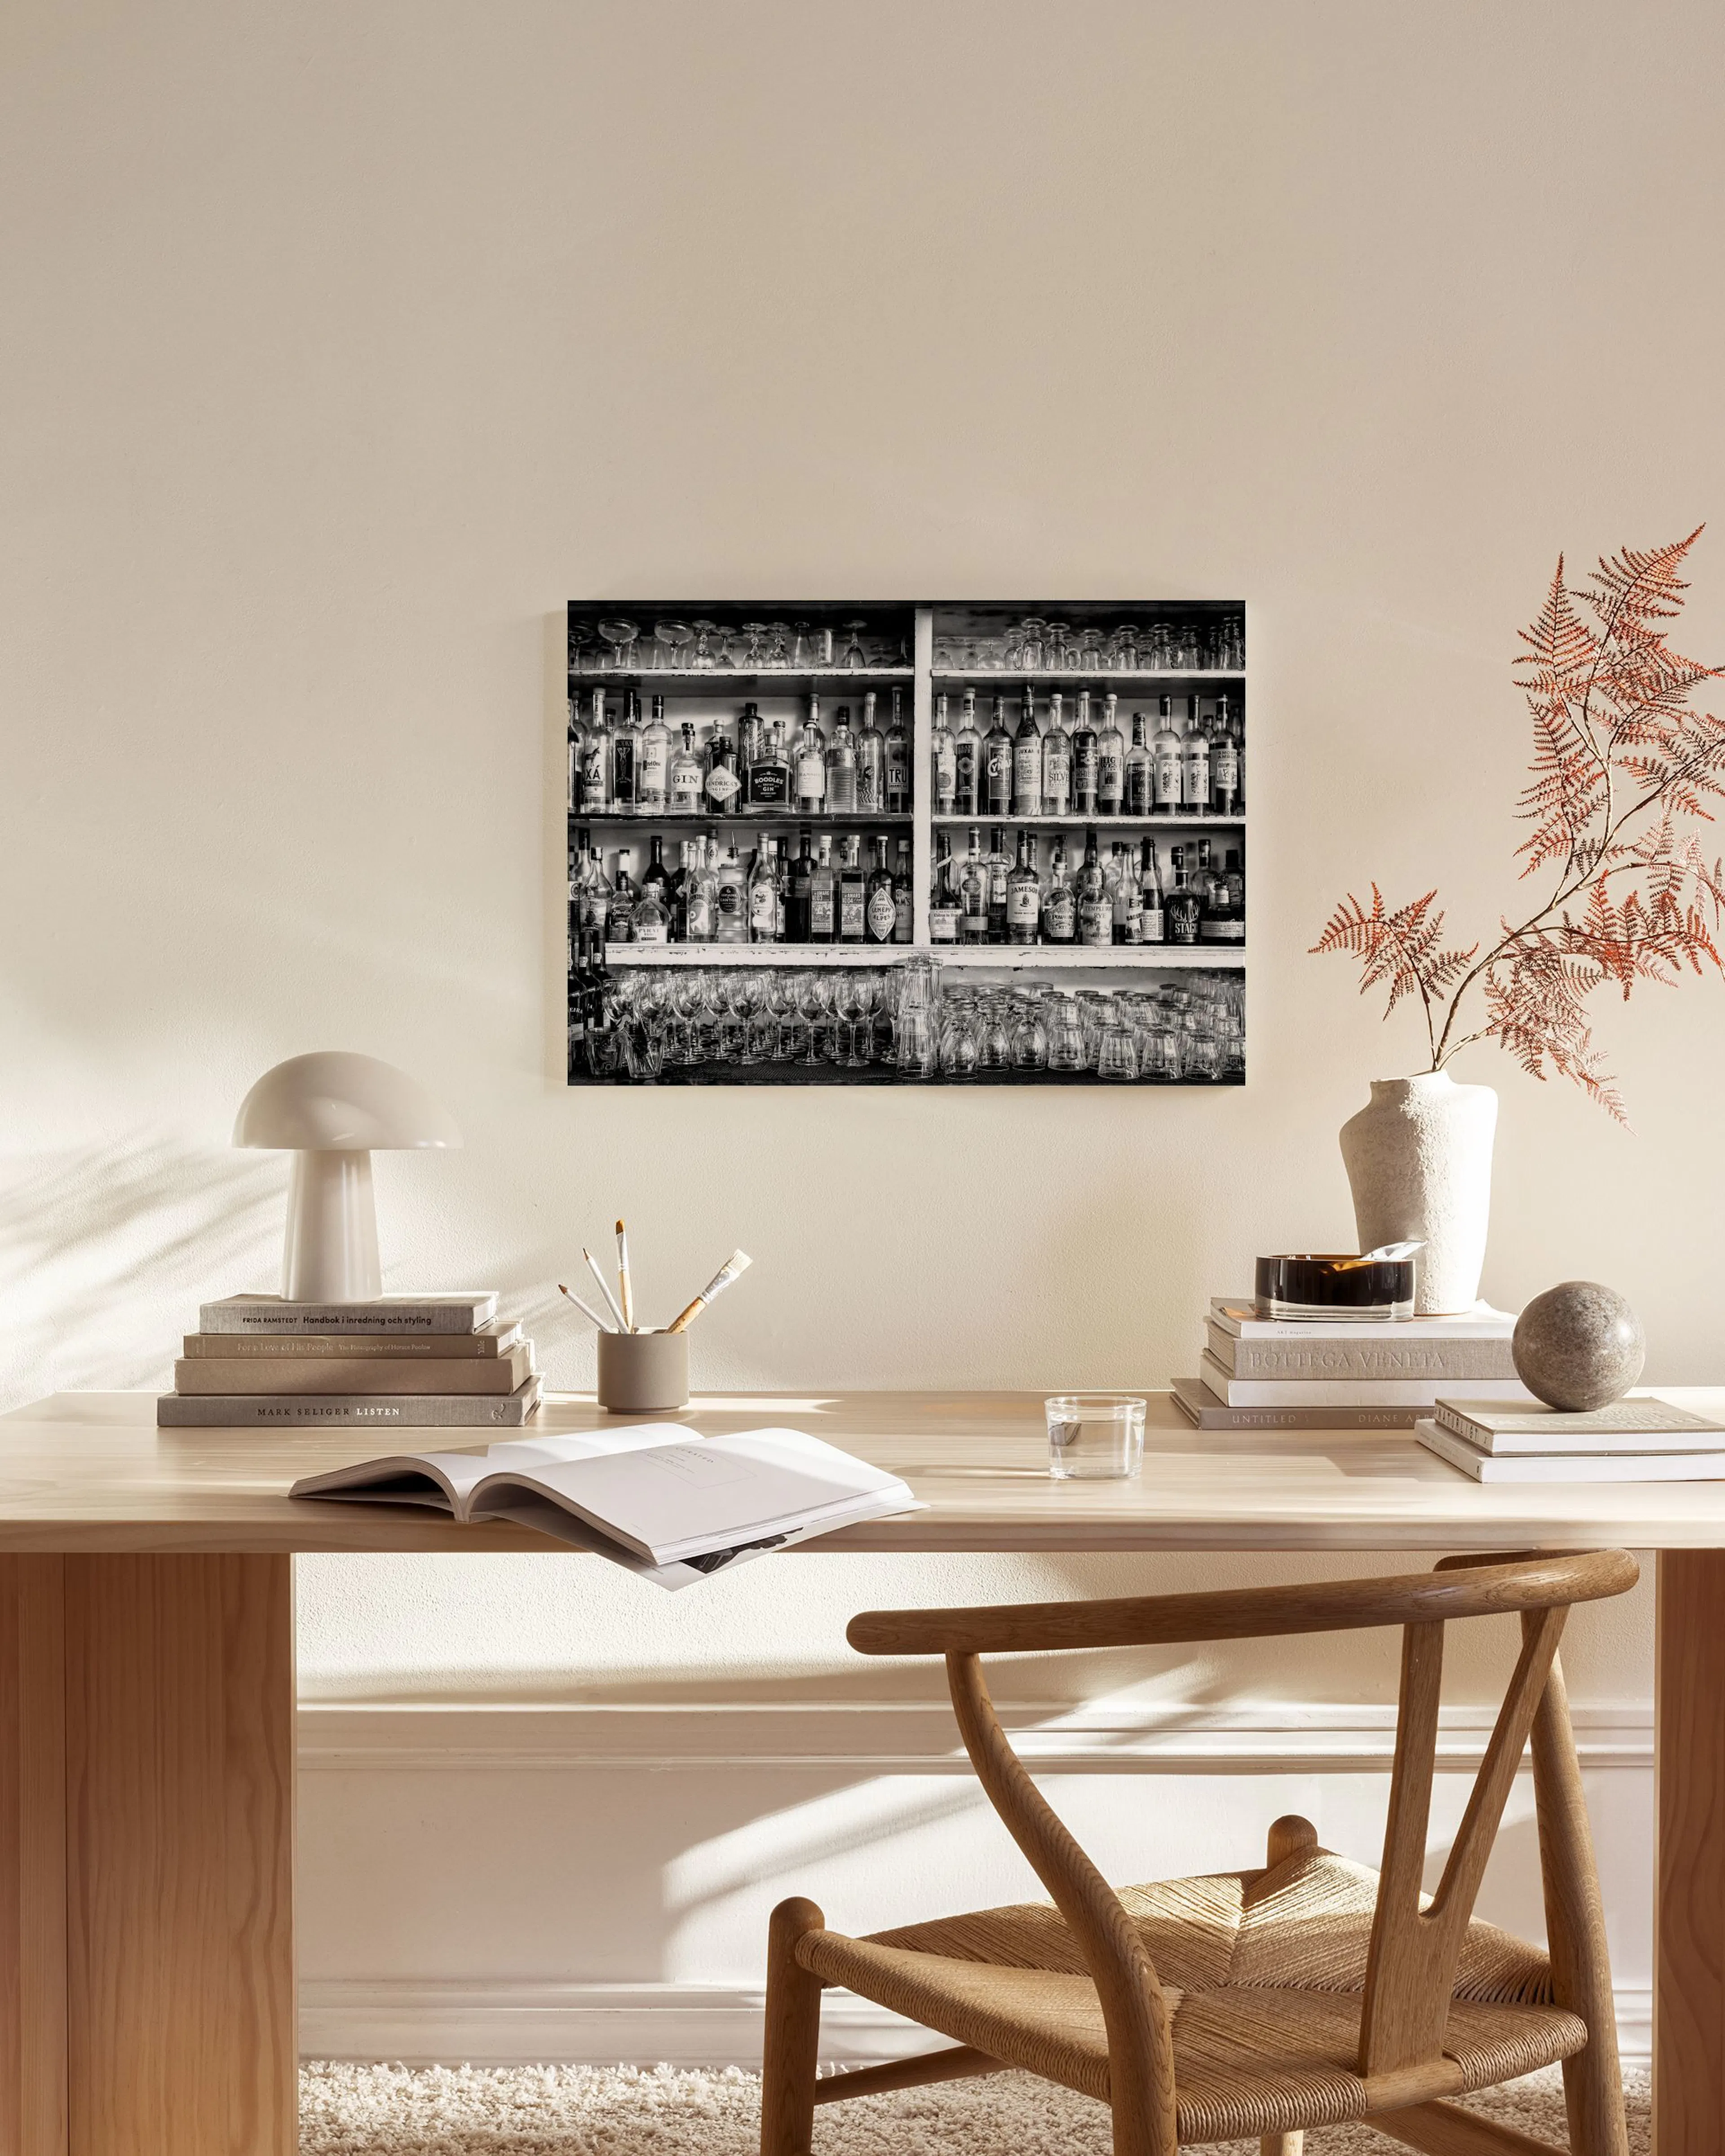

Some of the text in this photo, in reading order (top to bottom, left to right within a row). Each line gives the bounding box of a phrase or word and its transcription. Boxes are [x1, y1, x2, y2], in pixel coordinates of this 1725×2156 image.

[673, 775, 698, 783] GIN
[754, 776, 783, 785] BOODLES
[346, 1317, 385, 1325] inredning
[404, 1317, 432, 1325] styling
[261, 1343, 279, 1351] Love
[292, 1343, 304, 1351] His
[307, 1343, 334, 1353] People
[1251, 1352, 1445, 1368] BOTTEGA VENETA
[1232, 1414, 1296, 1423] UNTITLED
[1358, 1414, 1398, 1423] DIANE
